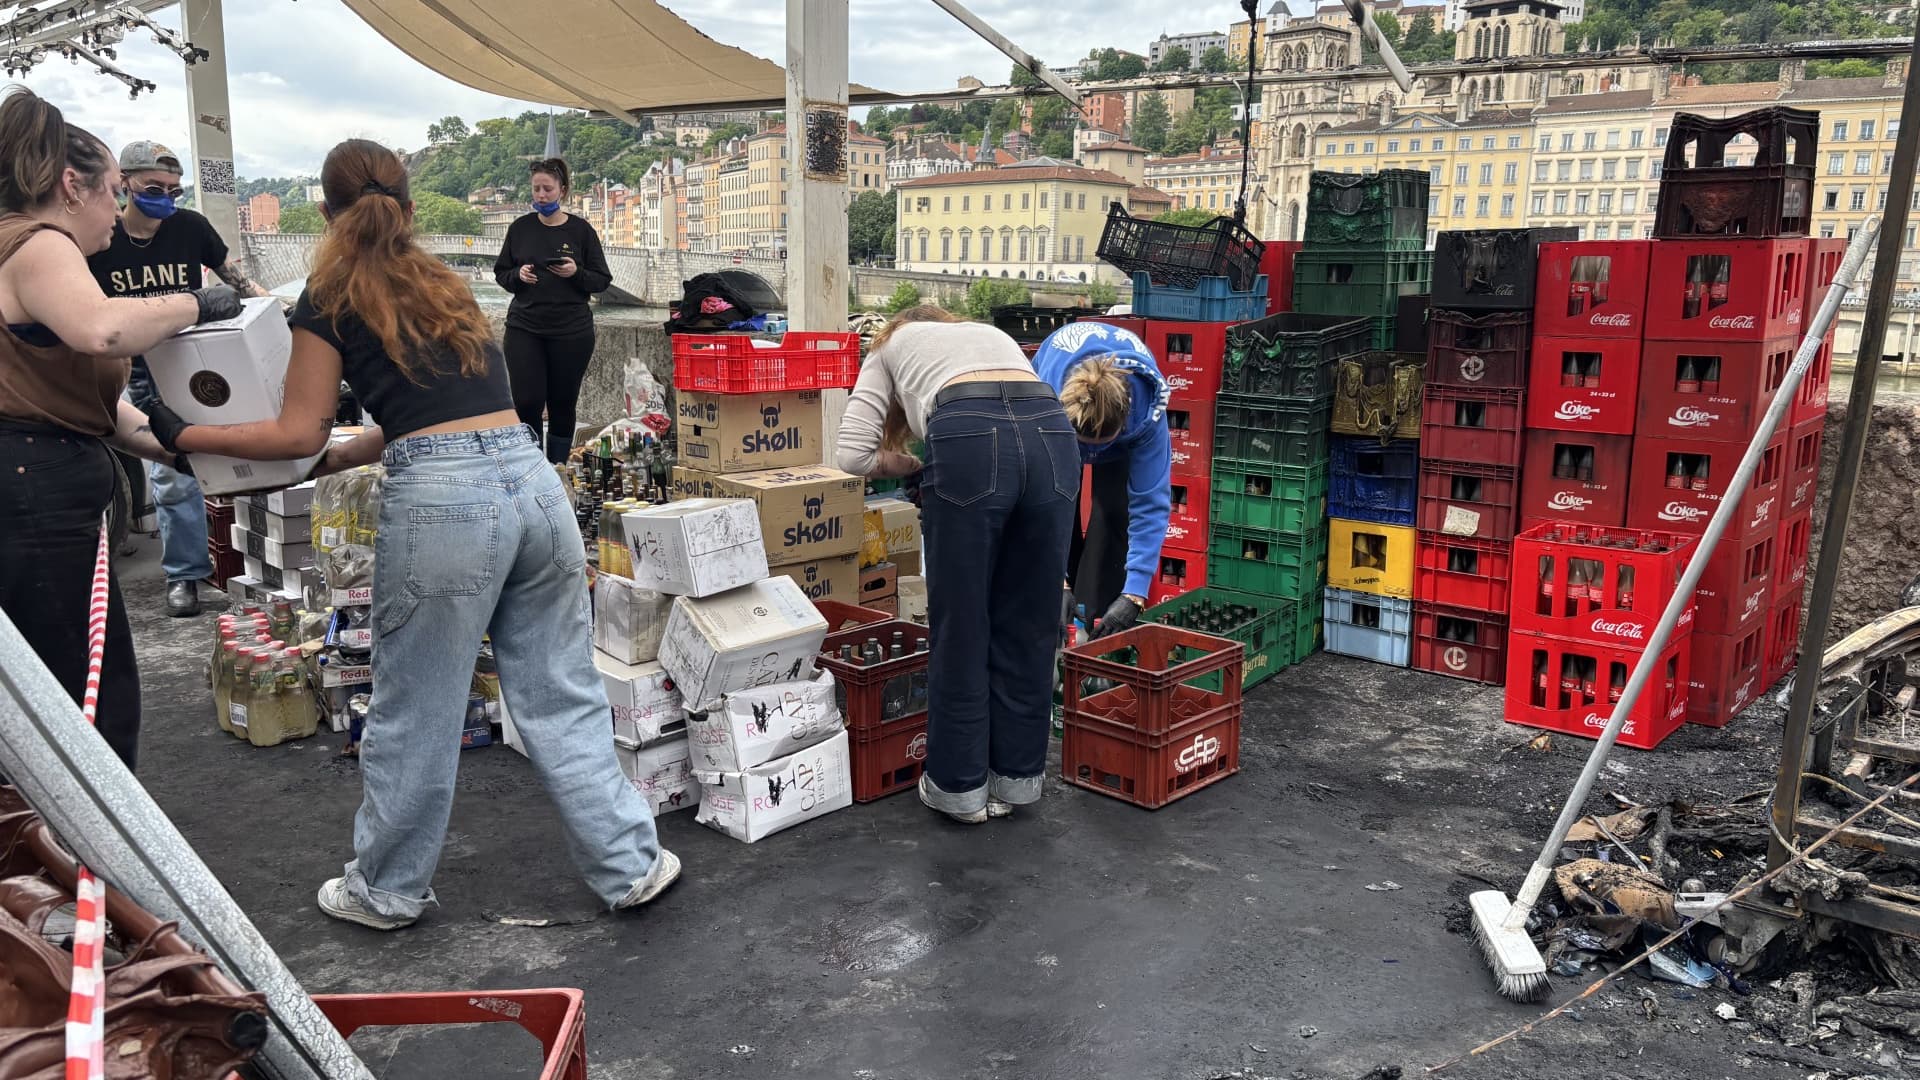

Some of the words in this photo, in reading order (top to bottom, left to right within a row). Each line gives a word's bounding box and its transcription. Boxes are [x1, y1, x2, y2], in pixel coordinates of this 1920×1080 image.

[111, 263, 189, 293] SLANE
[1590, 312, 1632, 326] Coca-Cola
[1709, 315, 1755, 329] Coca-Cola
[799, 391, 819, 400] BEER
[1560, 400, 1592, 416] Coke
[1675, 406, 1710, 421] Coke
[742, 426, 799, 454] skøll
[842, 479, 862, 489] BEER
[1553, 491, 1584, 506] Coke
[1664, 501, 1699, 517] Coke
[783, 515, 841, 547] skøll
[348, 589, 369, 598] Red
[800, 578, 830, 600] køll
[357, 630, 371, 640] Re
[1591, 617, 1644, 640] Coca-Cola
[340, 670, 362, 680] Red
[784, 691, 808, 740] CAP
[797, 763, 816, 812] CAP
